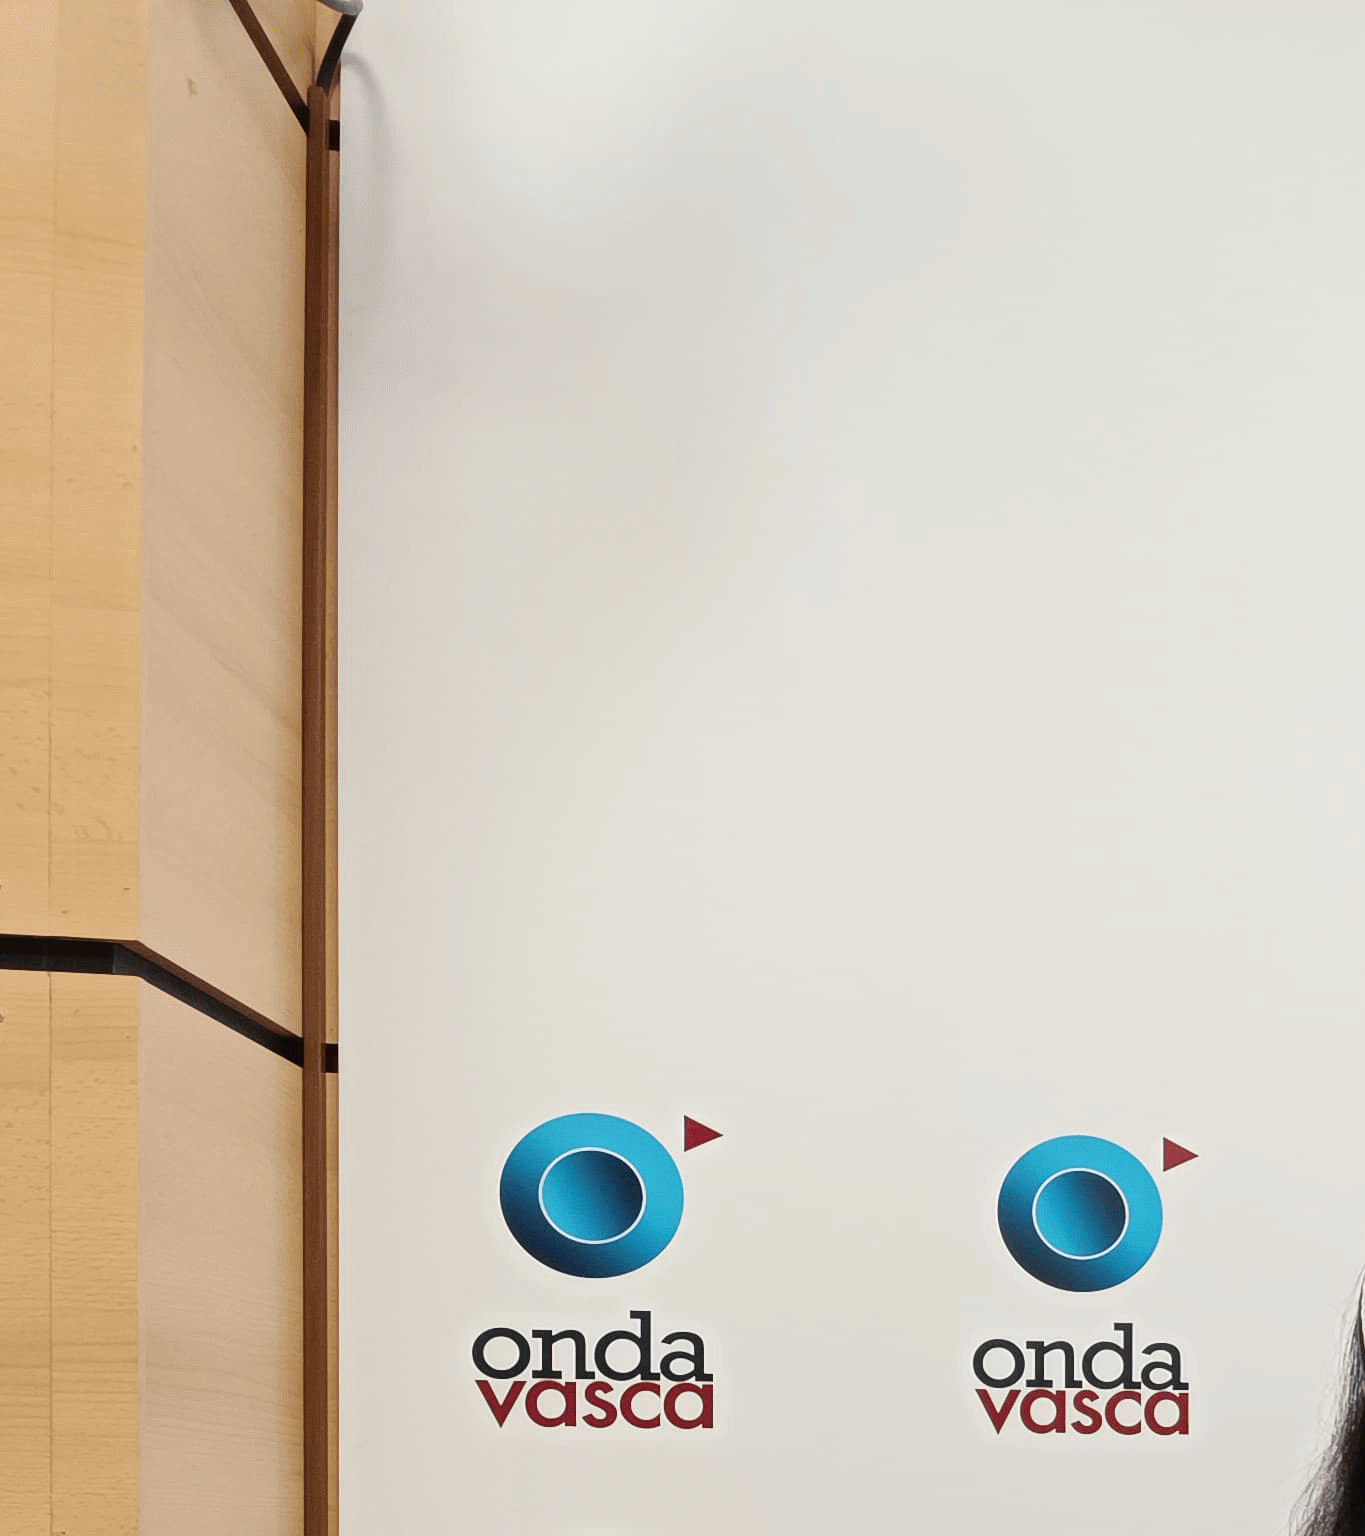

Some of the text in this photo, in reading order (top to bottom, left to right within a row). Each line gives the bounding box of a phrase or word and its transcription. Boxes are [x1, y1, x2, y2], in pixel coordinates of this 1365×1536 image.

[471, 1310, 714, 1383] onda
[972, 1322, 1190, 1391] onda
[475, 1378, 714, 1429] vasca
[975, 1387, 1190, 1436] vasca
